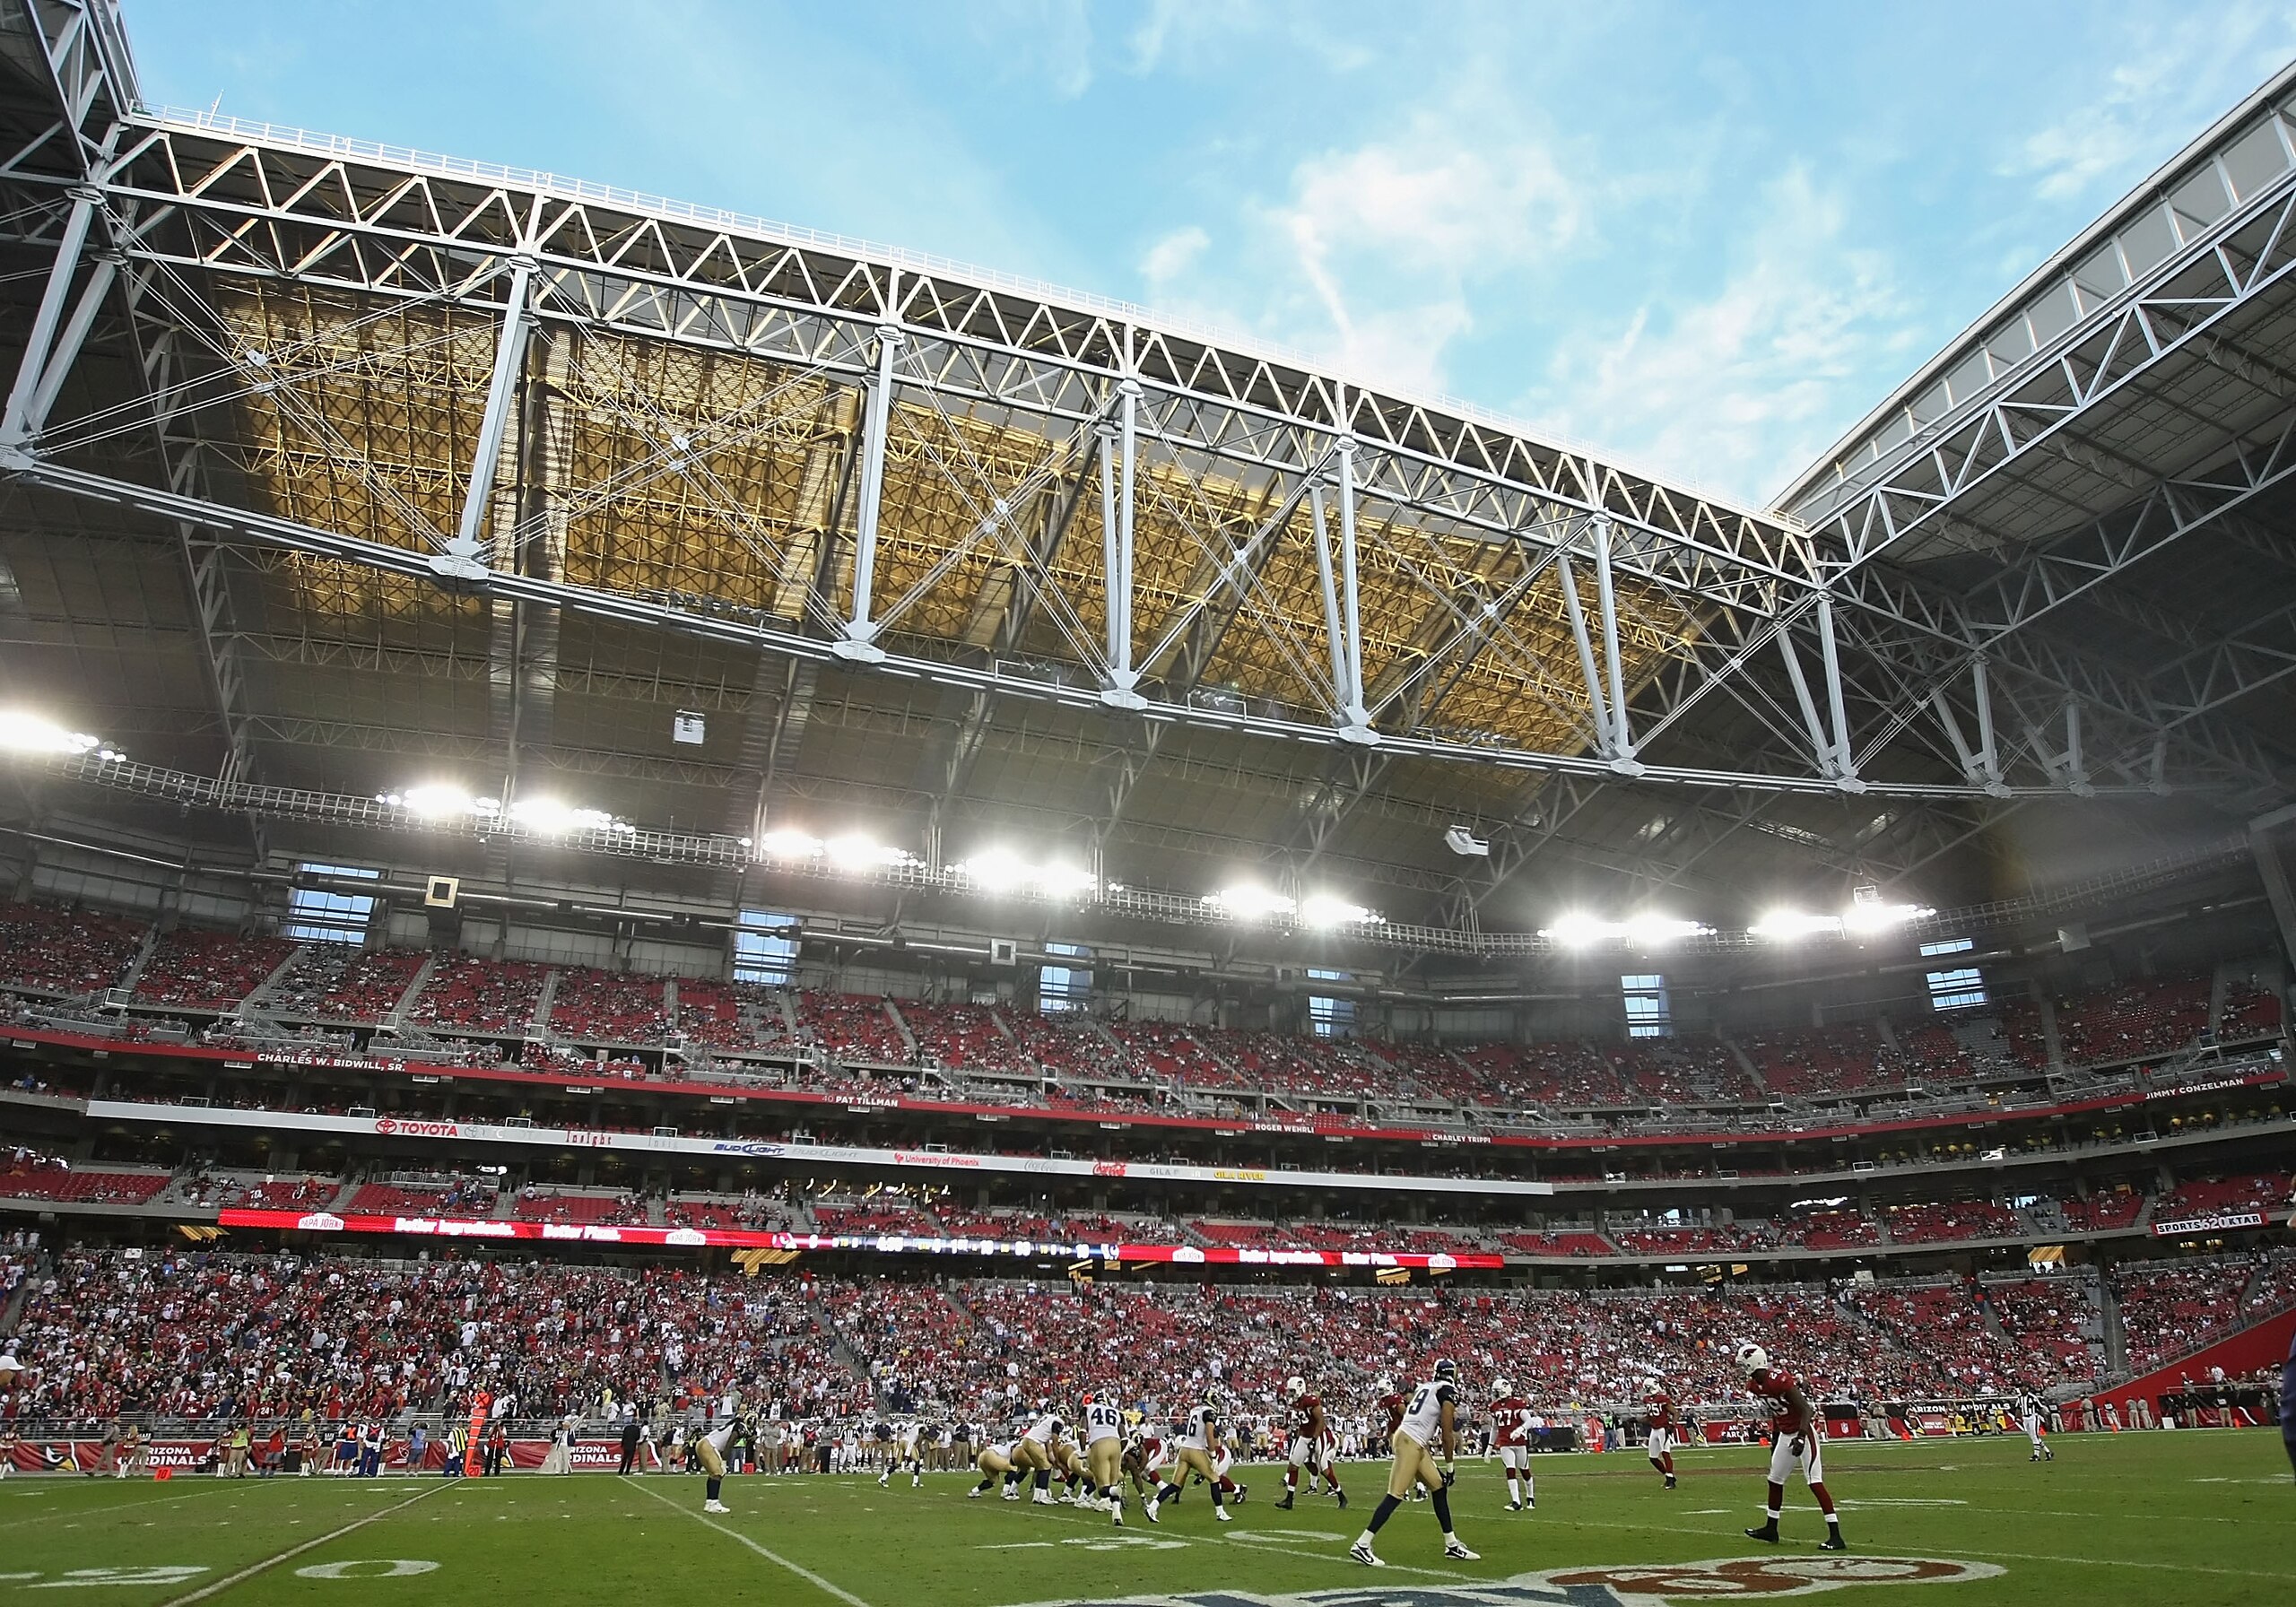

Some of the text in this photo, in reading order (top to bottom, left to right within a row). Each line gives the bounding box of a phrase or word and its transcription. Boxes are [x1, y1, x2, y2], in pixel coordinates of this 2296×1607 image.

[257, 1053, 405, 1072] CHARLES W. BIDWILL, SR.
[2145, 1078, 2244, 1099] JIMMY CONZELMAN
[835, 1096, 855, 1104] PAT
[856, 1097, 899, 1108] TILLMAN
[400, 1122, 458, 1137] TOYOTA
[1255, 1123, 1283, 1132] ROGER
[1283, 1125, 1315, 1134] WEHRLI
[1432, 1134, 1466, 1142] CHARLEY
[714, 1143, 786, 1155] BUD LIGHT
[905, 1154, 979, 1167] University of Phoenix
[1237, 1171, 1265, 1181] RIVER
[2158, 1215, 2261, 1232] SPORTS 620 KTAR
[1091, 1407, 1118, 1427] 46
[1495, 1409, 1512, 1427] 27
[865, 1423, 875, 1434] 84
[1257, 1419, 1266, 1428] 70
[158, 1469, 169, 1480] 10
[469, 1466, 479, 1477] 20
